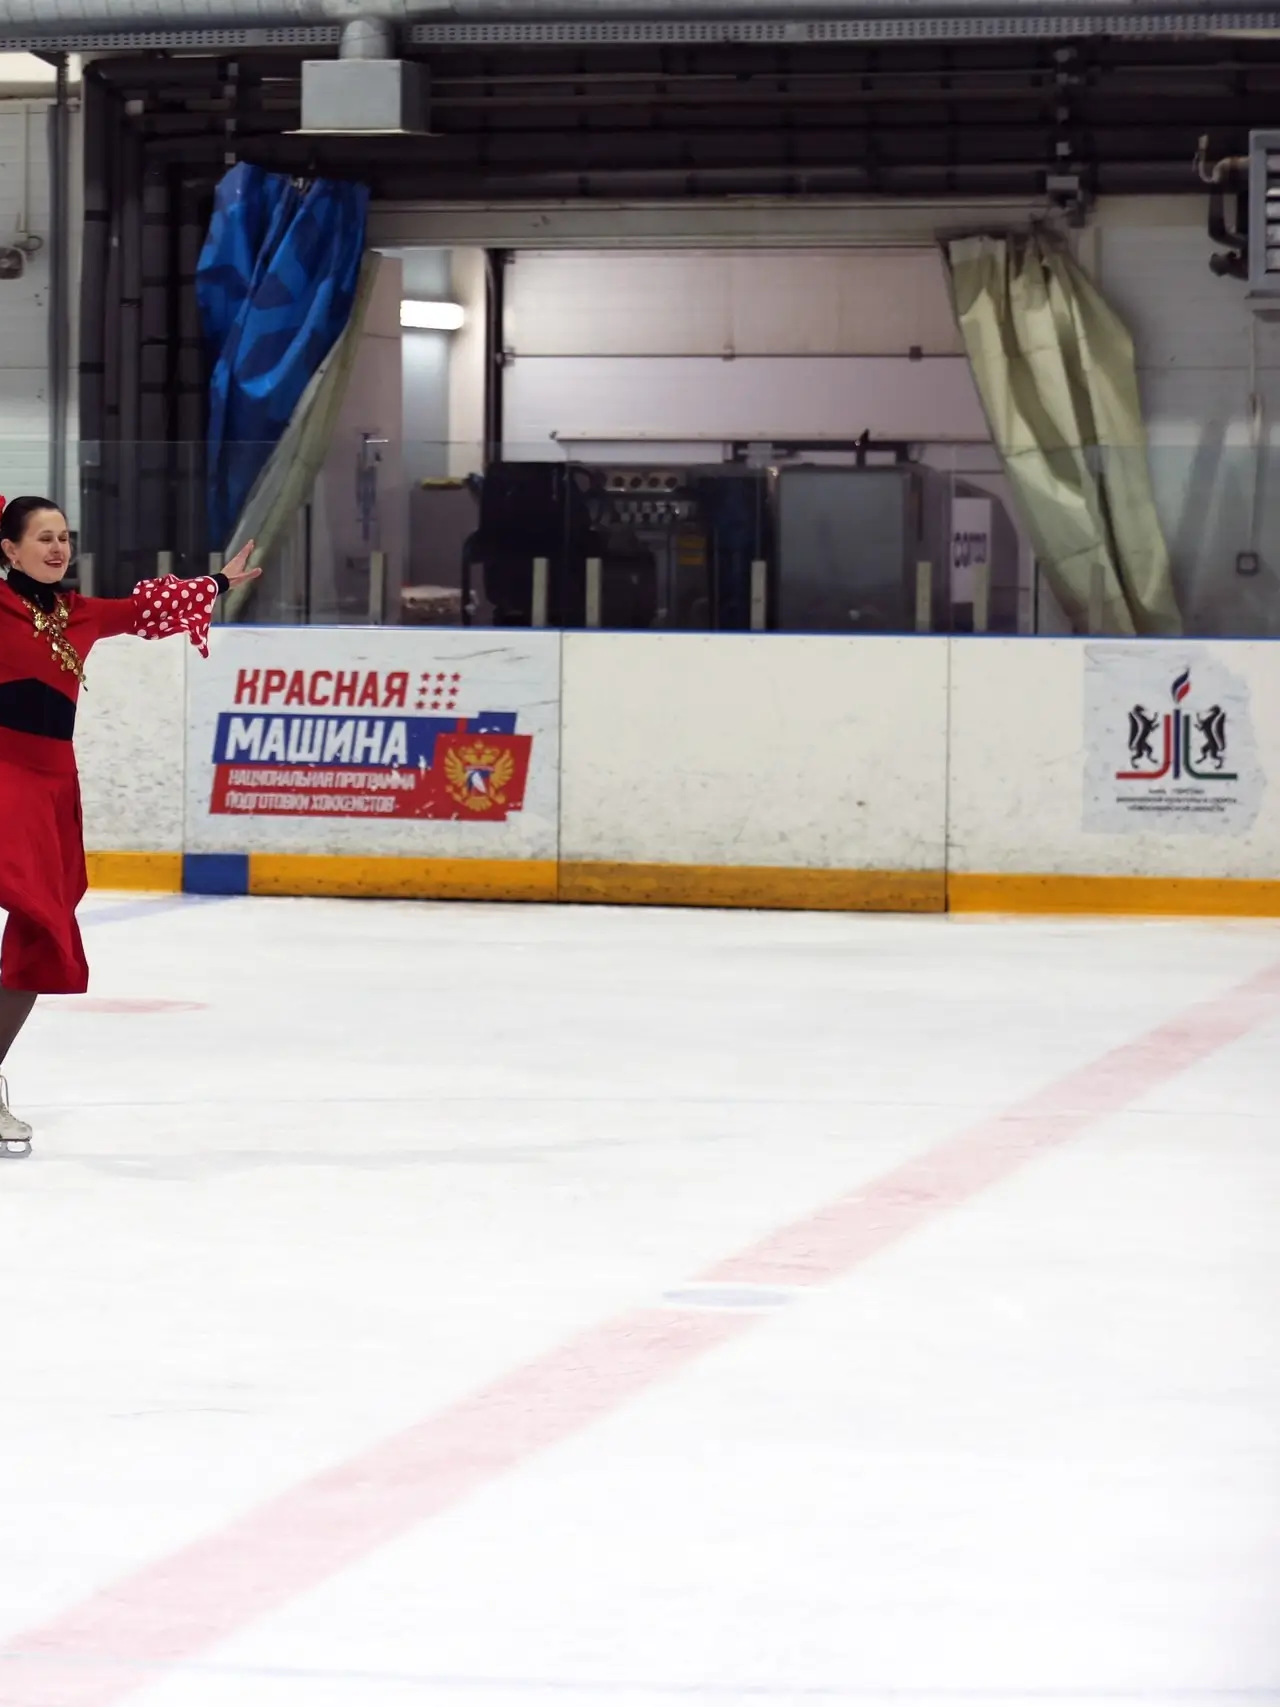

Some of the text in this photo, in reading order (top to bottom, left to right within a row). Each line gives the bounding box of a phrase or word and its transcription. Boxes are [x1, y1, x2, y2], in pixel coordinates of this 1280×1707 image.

[234, 669, 410, 708] КРАСНАЯ
[225, 717, 408, 764] МАШИНА
[228, 769, 334, 788] НАЦИОНАЛЬНАЯ
